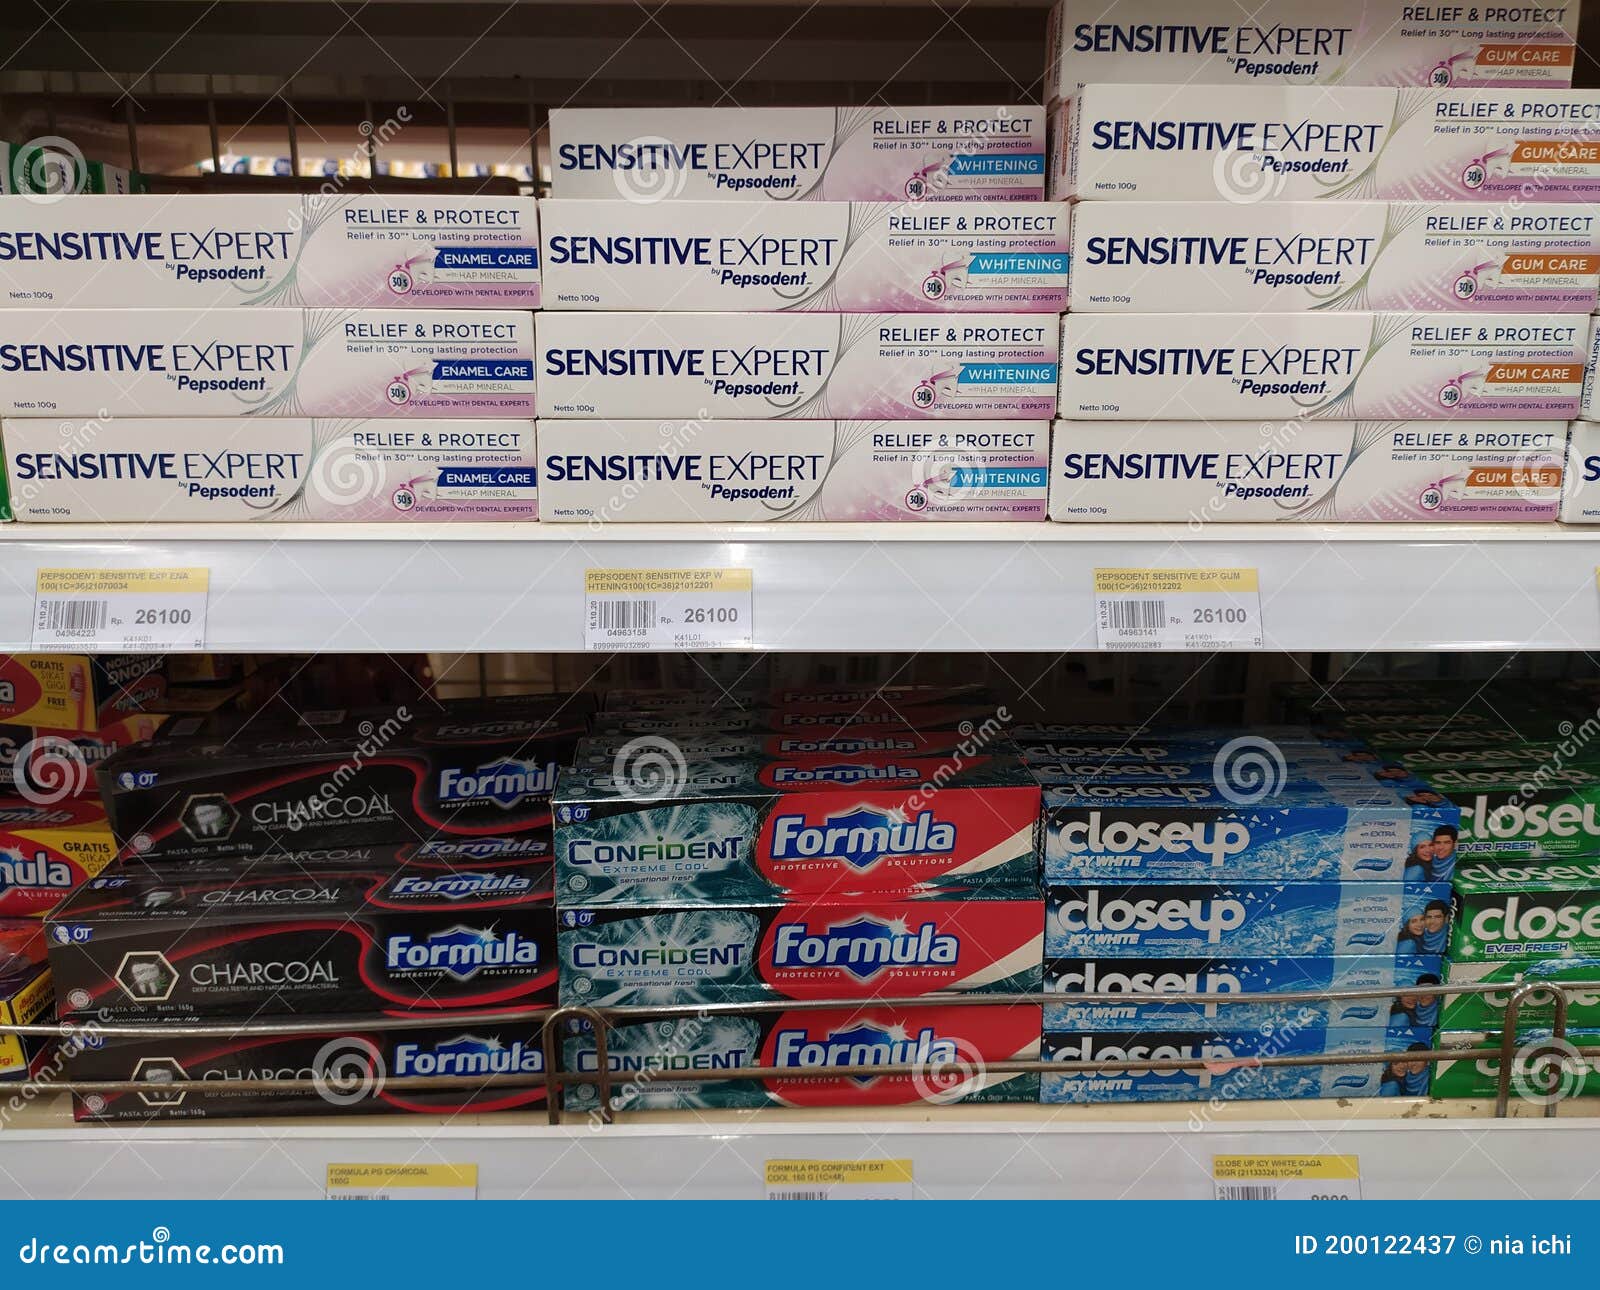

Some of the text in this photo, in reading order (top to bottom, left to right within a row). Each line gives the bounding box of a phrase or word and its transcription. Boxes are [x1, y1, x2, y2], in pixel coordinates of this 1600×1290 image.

[1074, 23, 1352, 55] SENSITIVE EXPERT
[1486, 51, 1560, 62] GUM CARE
[1234, 59, 1318, 77] Pepsodent
[1092, 119, 1383, 152] SENSITIVE EXPERT
[559, 140, 824, 170] SENSITIVE EXPERT
[959, 160, 1038, 171] WHITENING
[717, 174, 797, 190] Pepsodent
[345, 210, 519, 224] RELIEF & PROTECT
[0, 227, 293, 261] SENSITIVE EXPERT
[413, 233, 435, 241] Long
[439, 233, 470, 241] lasting
[473, 233, 521, 241] protection
[550, 234, 838, 266] SENSITIVE EXPERT
[1087, 233, 1375, 266] SENSITIVE EXPERT
[444, 255, 531, 264] ENAMEL CARE
[979, 258, 1062, 271] WHITENING
[1512, 259, 1587, 270] GUM CARE
[176, 264, 265, 280] Pepsodent
[1254, 268, 1340, 286] Pepsodent
[1412, 328, 1576, 341] RELIEF & PROTECT
[1, 340, 293, 372] SENSITIVE EXPERT
[546, 346, 829, 376] SENSITIVE EXPERT
[1076, 345, 1361, 375] SENSITIVE EXPERT
[969, 370, 1050, 379] WHITENING
[1496, 369, 1570, 379] GUM CARE
[714, 380, 798, 397] Pepsodent
[38, 401, 56, 410] 100g
[1101, 404, 1120, 412] 100g
[16, 450, 303, 480] SENSITIVE EXPERT
[546, 452, 824, 482] SENSITIVE EXPERT
[1064, 450, 1342, 480] SENSITIVE EXPERT
[447, 473, 531, 484] ENAMEL CARE
[960, 472, 1040, 484] WHITENING
[189, 483, 275, 500] Pepsodent
[1225, 483, 1308, 500] Pepsodent
[136, 610, 191, 624] 26100
[685, 608, 738, 622] 26100
[1194, 609, 1246, 623] 26100
[30, 660, 64, 671] GRATIS
[775, 766, 919, 781] Formula
[1053, 784, 1211, 801] closeup
[252, 795, 393, 823] CHARCOAL
[574, 808, 591, 819] OT
[773, 812, 954, 856] Formula
[1060, 811, 1250, 867] closeup
[63, 842, 110, 853] GRATIS
[421, 839, 547, 853] Formula
[1458, 843, 1493, 851] EVER
[1496, 842, 1536, 850] FRESH
[603, 863, 708, 873] EXTREME COOL
[773, 863, 839, 871] PROTECTIVE
[1095, 856, 1142, 866] WHITE
[393, 876, 530, 891] Formula
[620, 875, 669, 884] sensational
[202, 888, 340, 901] CHARCOAL
[579, 912, 595, 924] OT
[1057, 890, 1246, 943] closeup
[73, 928, 92, 939] OT
[1093, 934, 1140, 944] WHITE
[388, 933, 537, 967] Formula
[775, 925, 958, 963] Formula
[1486, 943, 1568, 952] EVER FRESH
[191, 961, 339, 984] CHARCOAL
[1092, 1008, 1137, 1018] WHITE
[775, 1029, 956, 1067] Formula
[397, 1042, 542, 1073] Formula
[1087, 1080, 1132, 1090] WHITE
